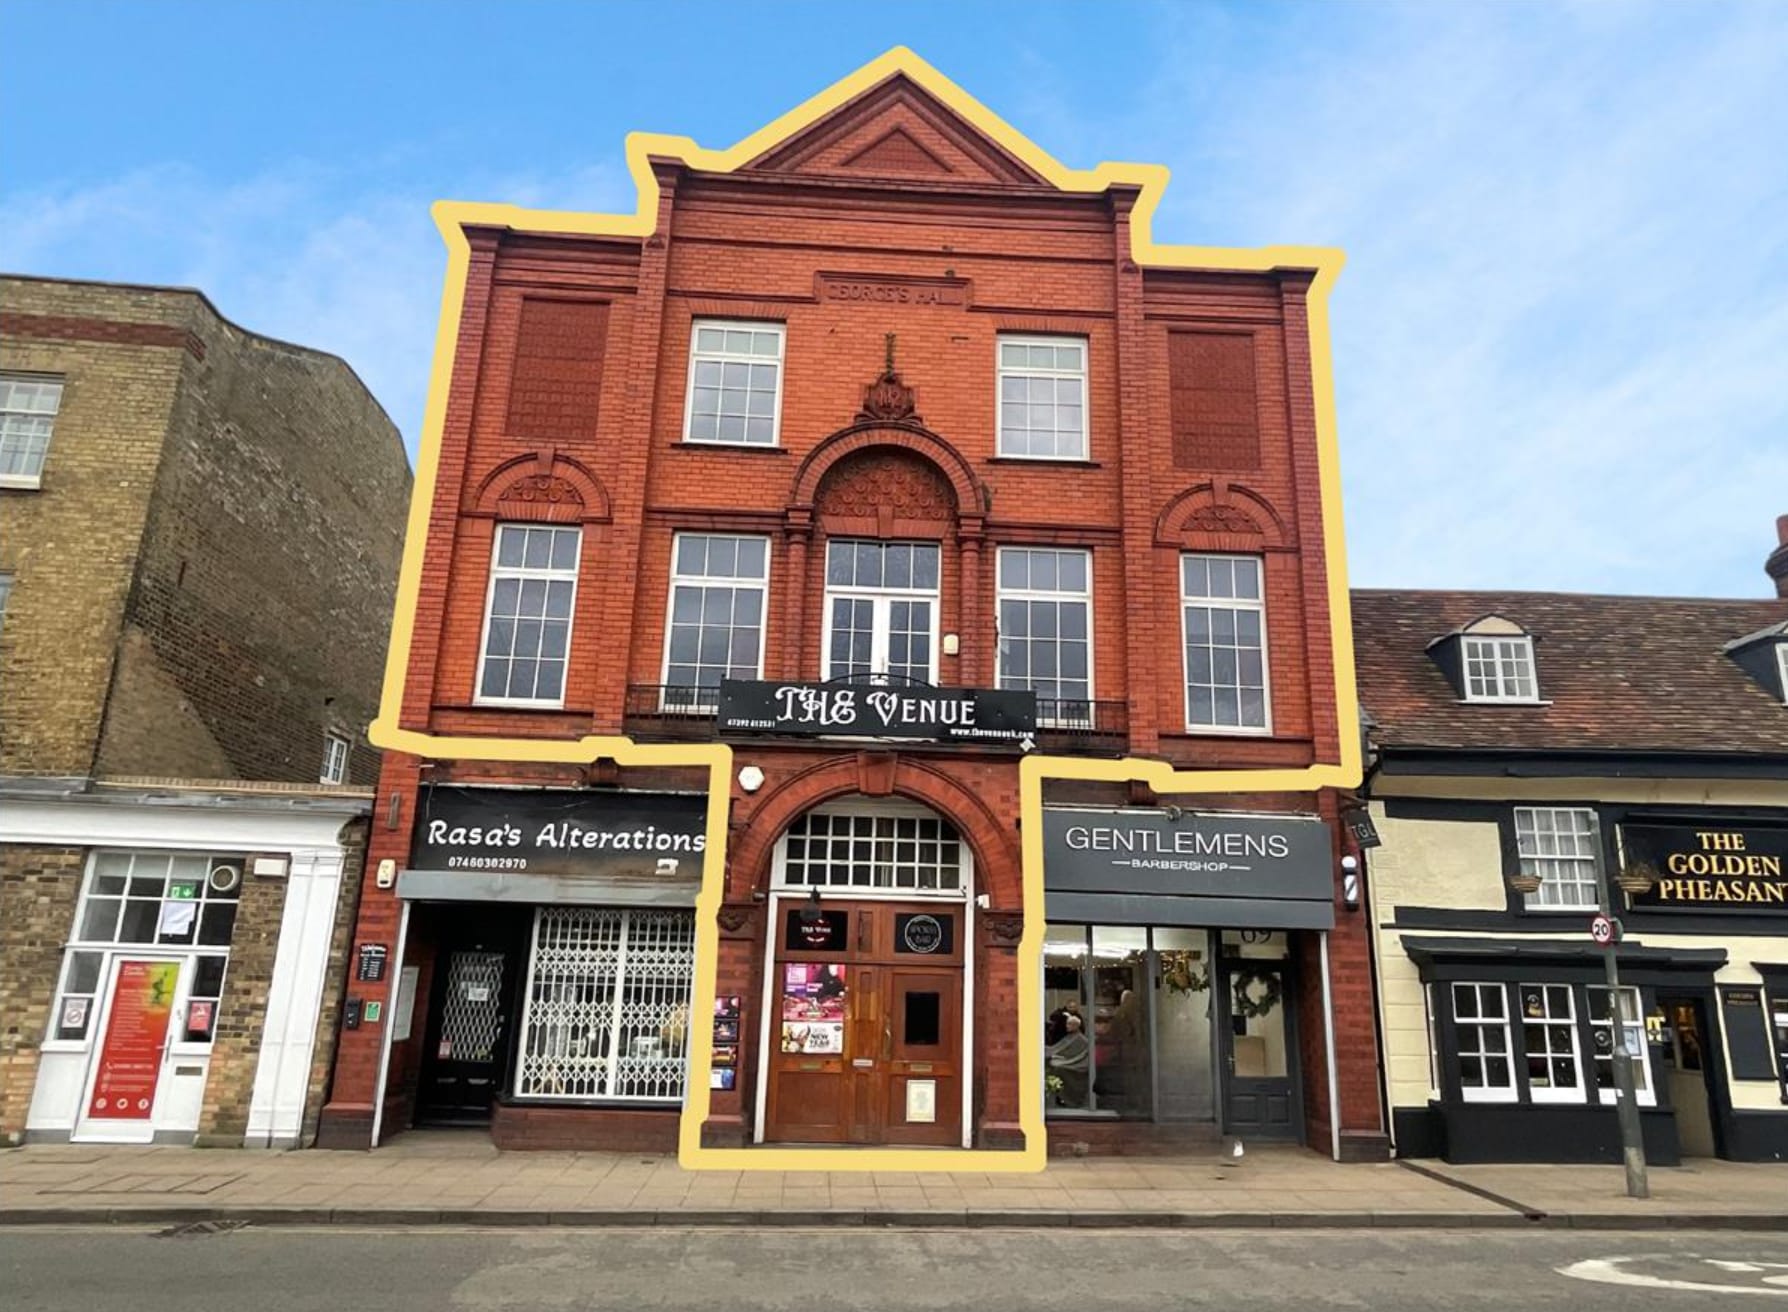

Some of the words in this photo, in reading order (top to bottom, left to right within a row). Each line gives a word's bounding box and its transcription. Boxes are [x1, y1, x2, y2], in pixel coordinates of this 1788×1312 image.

[775, 685, 857, 726] THE
[427, 819, 523, 848] Rasa's
[535, 822, 706, 852] Alterations
[1065, 826, 1290, 858] GENTLEMENS
[1696, 832, 1746, 851] THE
[448, 856, 528, 870] 07460302970
[1131, 858, 1229, 872] BARBERSHOP
[1668, 853, 1781, 877] GOLDEN
[1659, 879, 1788, 903] PHEASAN
[1594, 923, 1609, 937] 20
